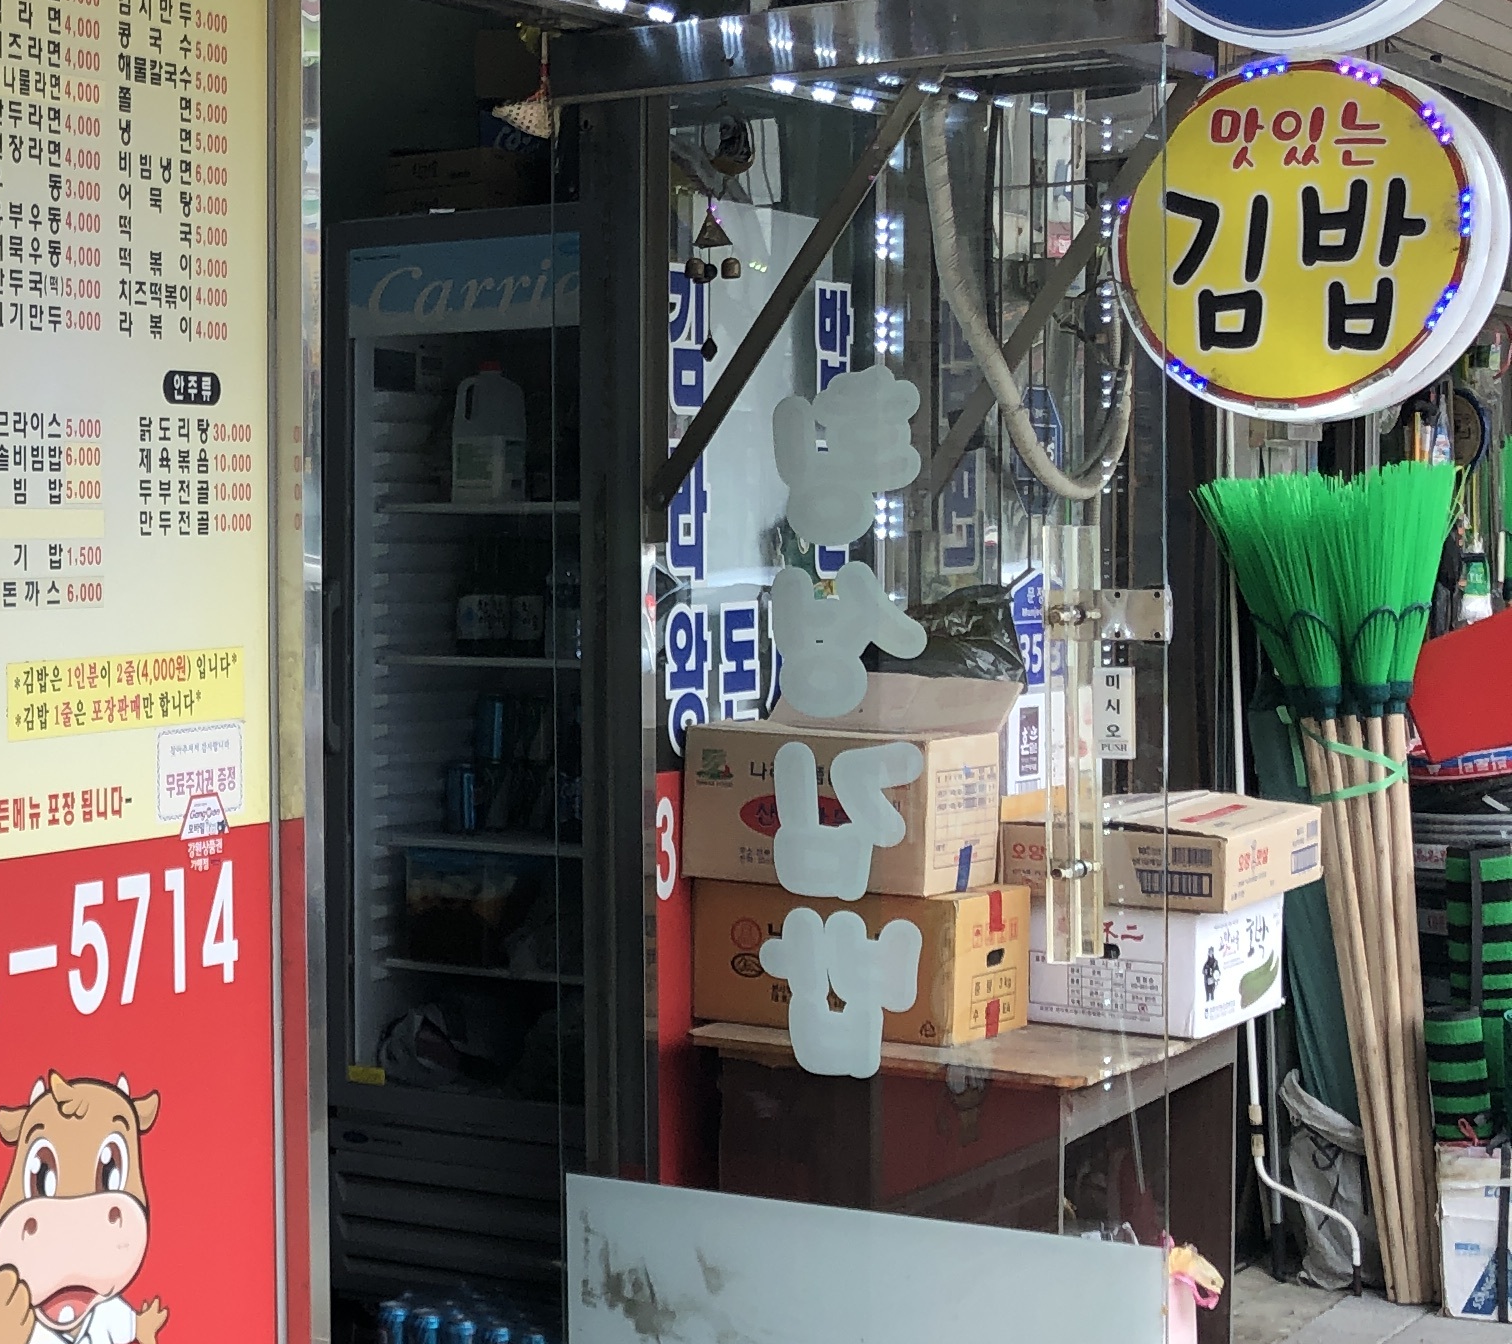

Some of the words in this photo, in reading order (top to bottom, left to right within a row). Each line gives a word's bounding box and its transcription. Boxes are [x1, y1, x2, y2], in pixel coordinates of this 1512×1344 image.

[64, 15, 100, 40] 4,000
[195, 9, 228, 34] 3,000
[64, 47, 100, 71] 4,000
[195, 41, 228, 65] 5,000
[118, 52, 192, 92] 해물칼국수
[195, 71, 228, 95] 5,000
[64, 80, 100, 104] 4,000
[195, 101, 228, 125] 5,000
[64, 114, 101, 137] 4,000
[1208, 101, 1389, 171] 맛있는
[195, 132, 228, 155] 5,000
[64, 147, 101, 171] 4,000
[118, 151, 192, 186] 비빔냉면
[195, 164, 228, 187] 6,000
[65, 178, 101, 203] 3,000
[195, 194, 228, 216] 3,000
[65, 210, 101, 234] 4,000
[195, 225, 228, 247] 5,000
[65, 245, 101, 268] 4,000
[195, 257, 228, 279] 3,000
[1164, 176, 1427, 354] 김밥
[65, 277, 101, 300] 5,000
[119, 278, 192, 312] 치즈떡볶이
[195, 286, 228, 308] 4,000
[65, 309, 101, 332] 3,000
[195, 320, 228, 341] 4,000
[173, 373, 212, 402] 안주류
[65, 418, 101, 439] 5,000
[139, 416, 210, 444] 닭도리탕
[213, 423, 251, 443] 30,000
[65, 446, 101, 467] 6,000
[139, 447, 209, 474] 제육볶음
[213, 454, 251, 473] 10,000
[65, 480, 101, 500] 5,000
[139, 479, 209, 505] 두부전골
[213, 482, 251, 501] 10,000
[139, 510, 209, 537] 만두전골
[213, 513, 251, 532] 10,000
[66, 546, 102, 566] 1,500
[67, 582, 103, 603] 6,000
[67, 660, 111, 690] 1인분이
[116, 654, 192, 686] 2줄(4,000원)
[54, 699, 87, 728] 1줄은
[91, 693, 154, 724] 포장판매만
[1104, 673, 1121, 738] 미시오
[1101, 742, 1128, 754] PUSH
[166, 768, 214, 798] 무료주차권
[217, 766, 236, 792] 증정
[47, 791, 75, 827] 포장
